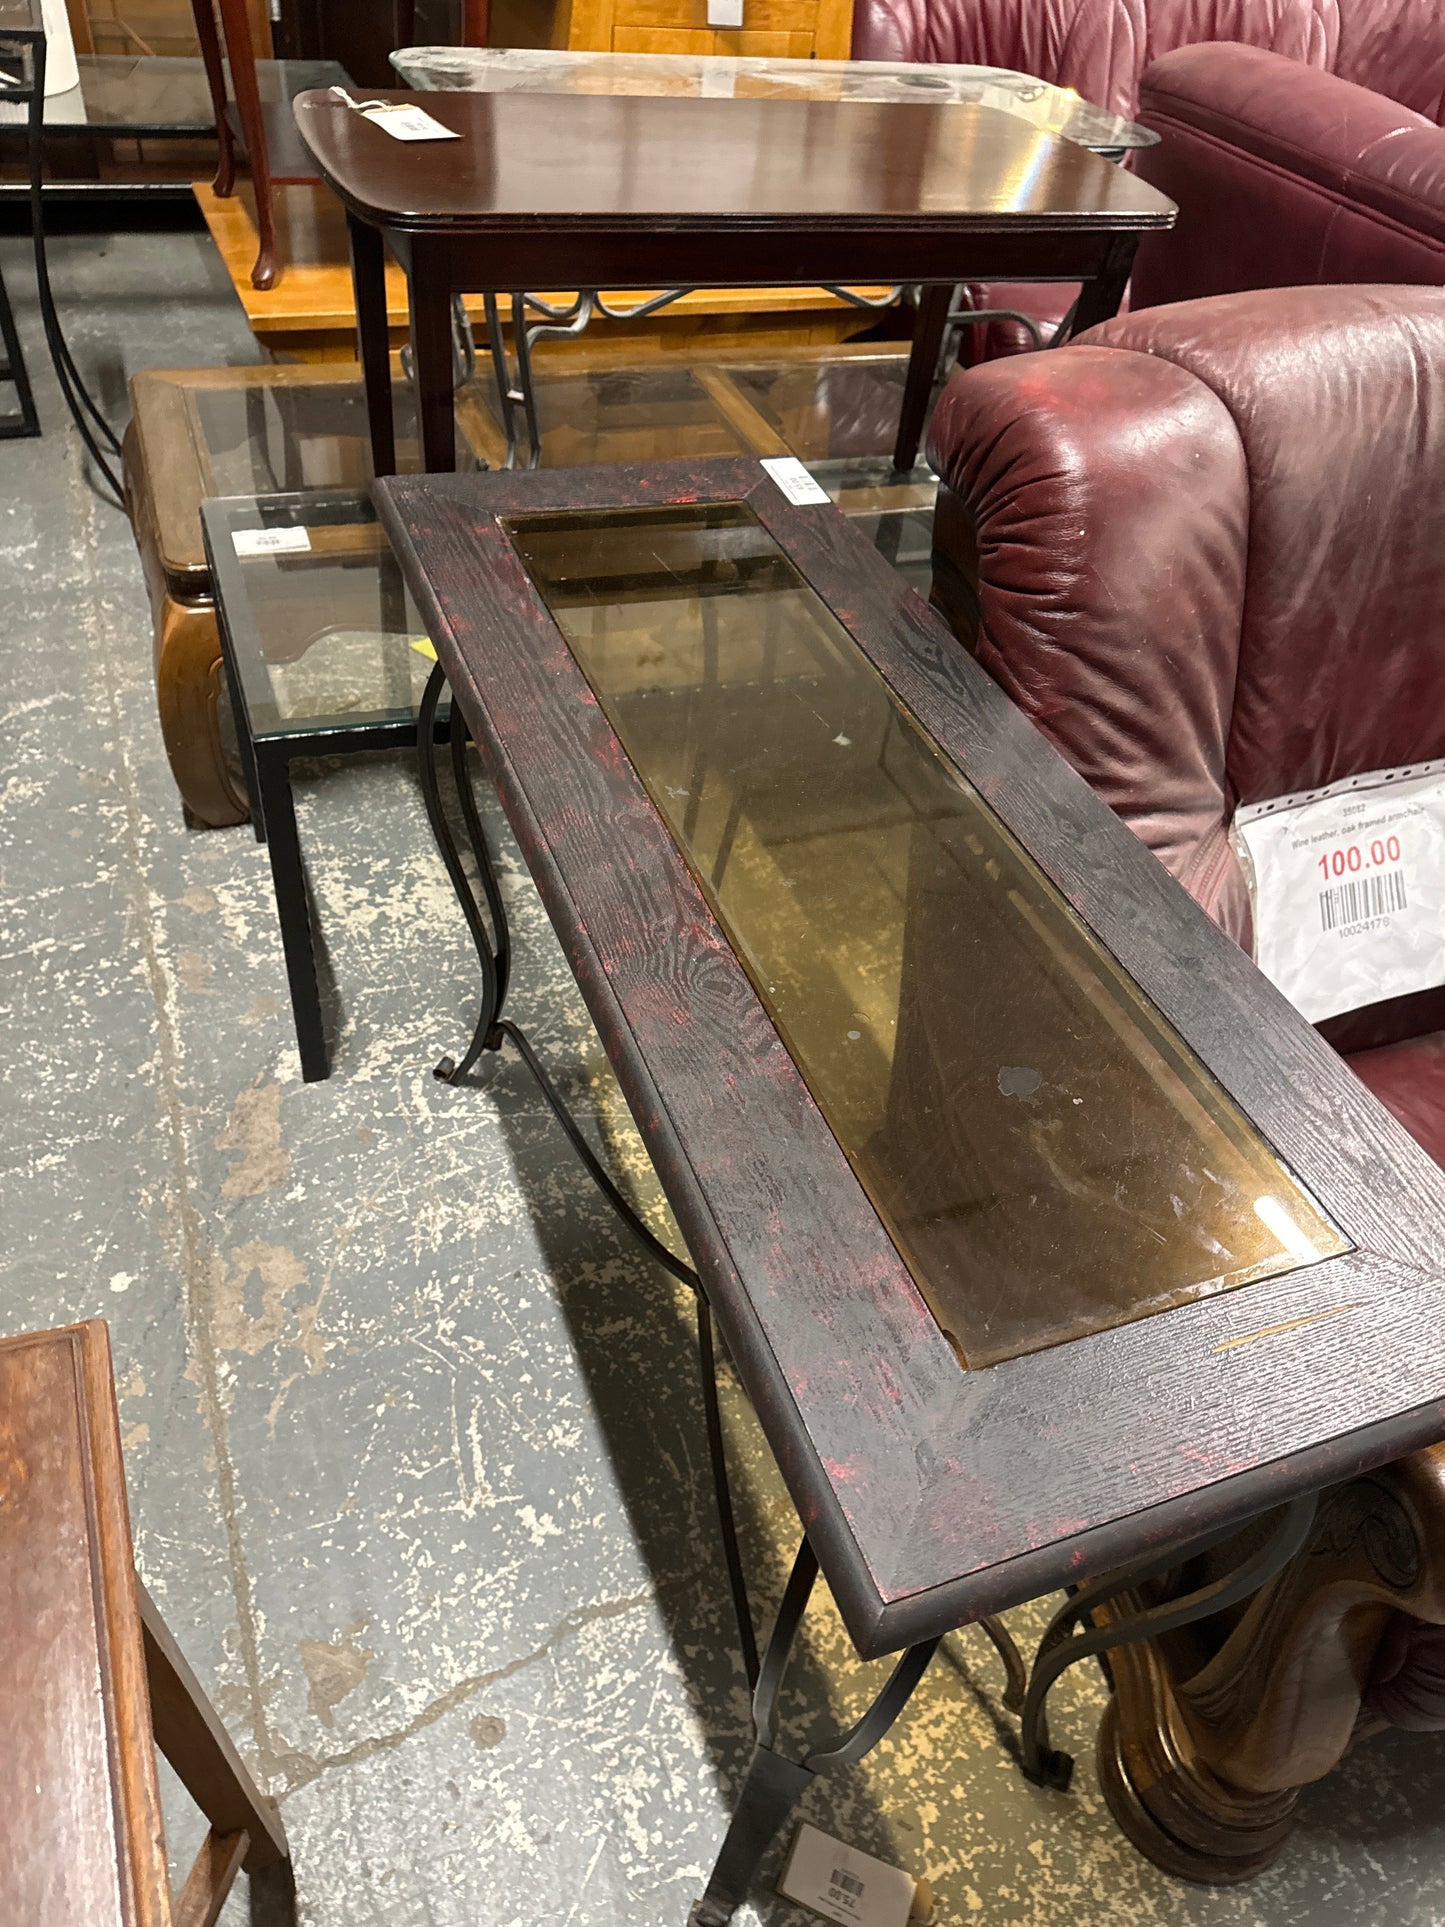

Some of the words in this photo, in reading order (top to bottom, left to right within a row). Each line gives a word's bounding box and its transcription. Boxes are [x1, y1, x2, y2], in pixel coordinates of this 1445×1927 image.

[1291, 837, 1310, 851] Wine
[1341, 825, 1356, 836] oak
[1357, 816, 1387, 831] framed
[1318, 835, 1402, 881] 100.00
[1339, 916, 1391, 939] 10024178
[828, 1887, 856, 1908] 75.00
